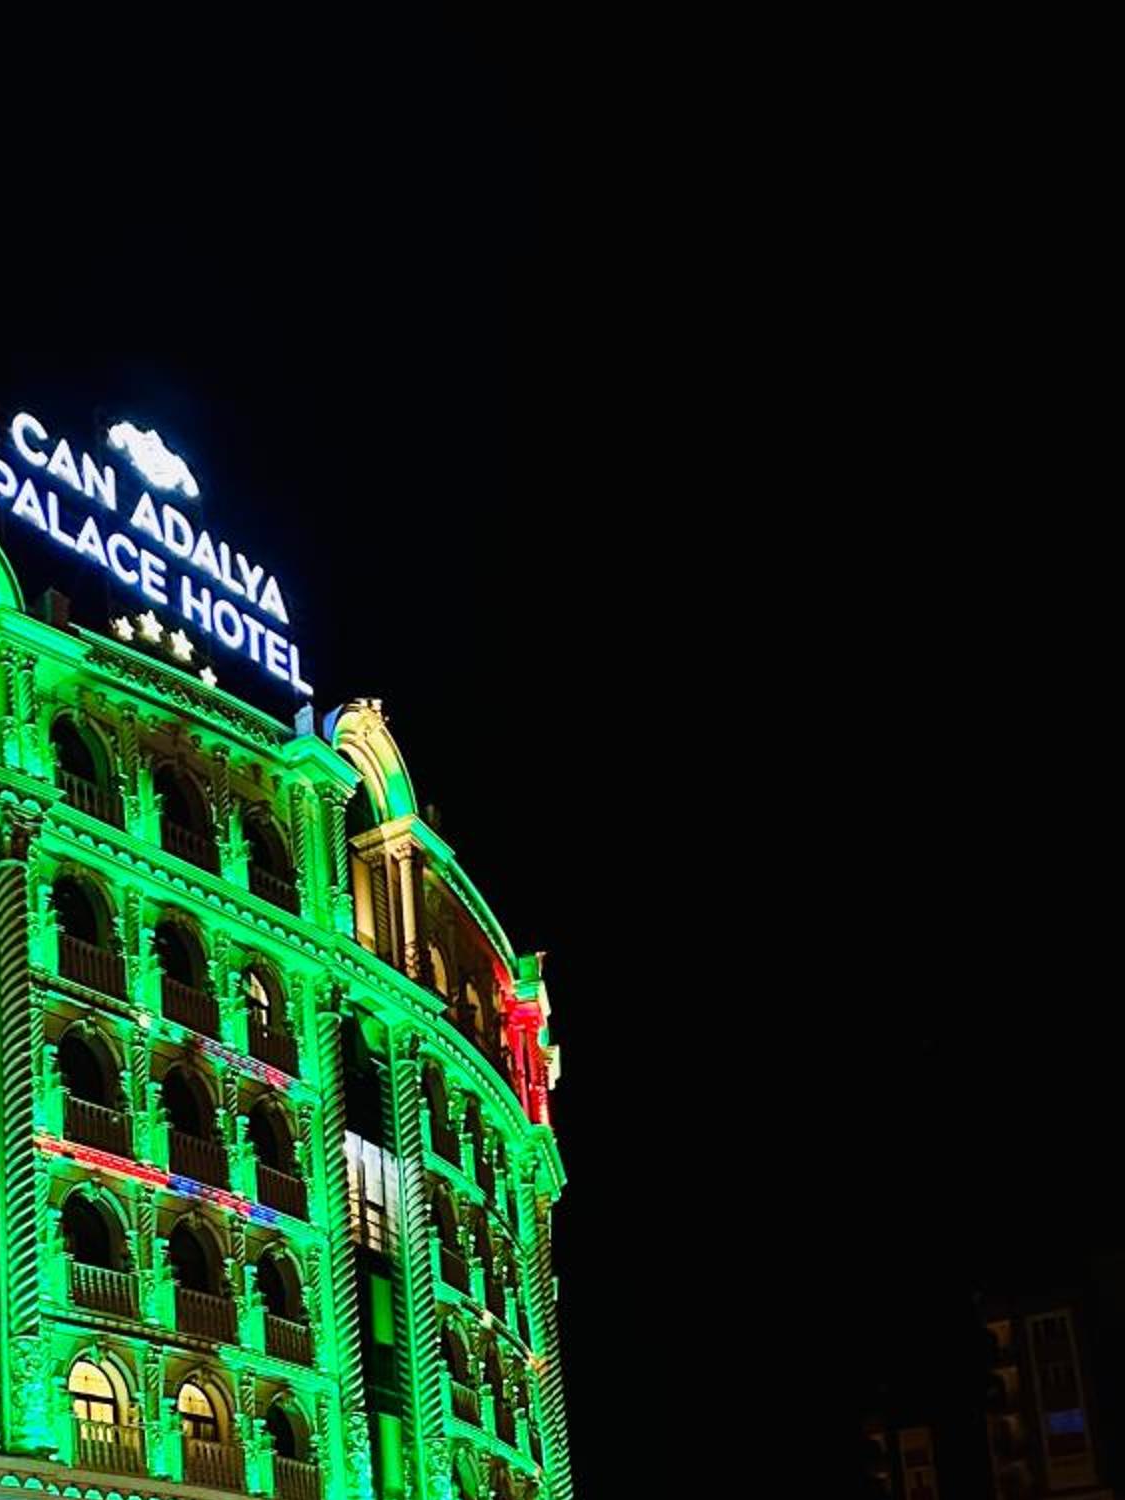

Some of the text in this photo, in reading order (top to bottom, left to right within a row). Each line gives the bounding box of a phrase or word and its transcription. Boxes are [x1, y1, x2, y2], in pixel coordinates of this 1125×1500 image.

[11, 412, 289, 624] CAN ADALYA
[181, 575, 314, 696] HOTEL
